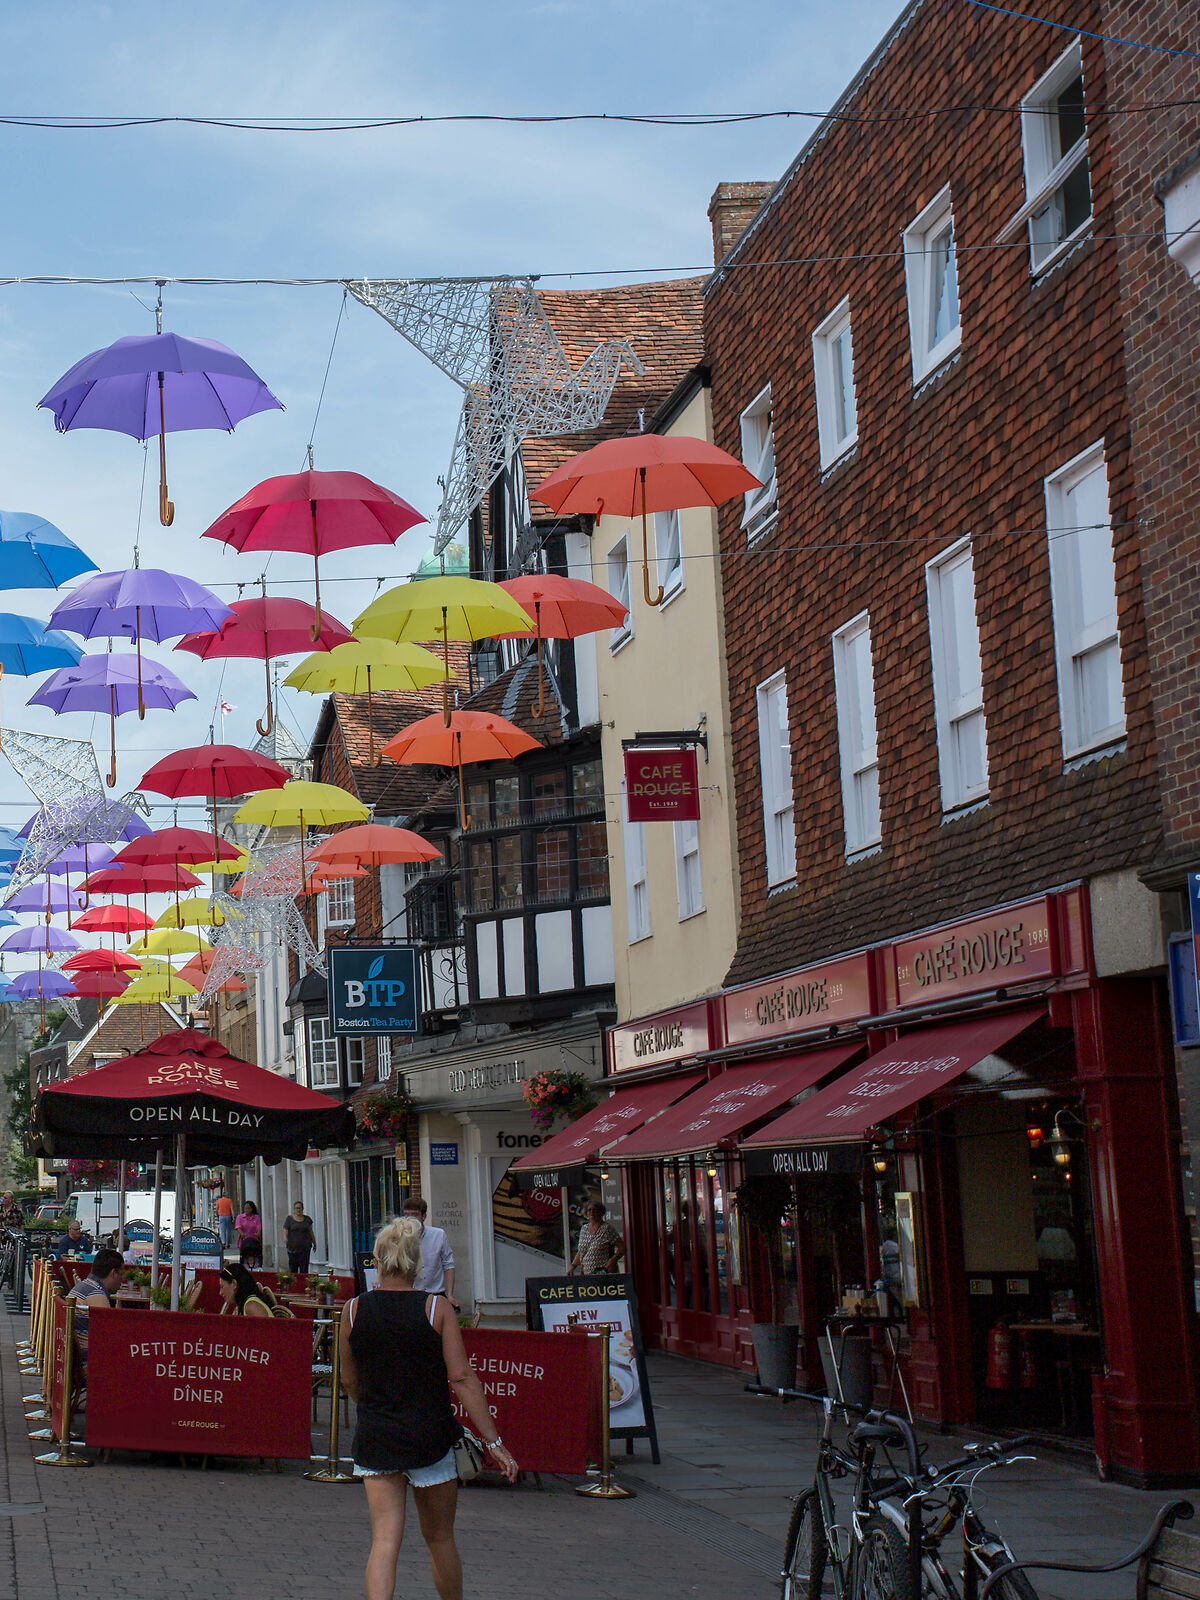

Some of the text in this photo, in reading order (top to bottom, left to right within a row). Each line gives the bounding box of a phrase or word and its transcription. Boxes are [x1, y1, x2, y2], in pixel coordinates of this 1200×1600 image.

[640, 763, 683, 779] CAFÉ
[633, 782, 692, 796] ROUGE
[913, 936, 958, 986] CAFÉ
[958, 923, 1025, 976] ROUGE
[1028, 928, 1049, 946] 1989
[343, 979, 406, 1008] BTP
[756, 985, 785, 1026] CAFÉ
[785, 978, 829, 1020] ROUGE
[337, 1017, 414, 1028] Boston Tea Party
[654, 1021, 684, 1053] ROUGE
[148, 1070, 240, 1090] ROUGE
[129, 1106, 265, 1128] OPEN ALL DAY
[497, 1131, 542, 1148] fone
[772, 1151, 829, 1173] OPEN ALL DAY
[530, 1188, 561, 1208] fone
[578, 1284, 626, 1297] ROUGE
[130, 1338, 270, 1366] PETIT DÉJEUNER
[155, 1360, 242, 1382] DÉJEUNER
[469, 1353, 545, 1381] ÉJEUNER
[173, 1384, 224, 1404] DÎNER
[196, 1421, 219, 1429] ROUGE
